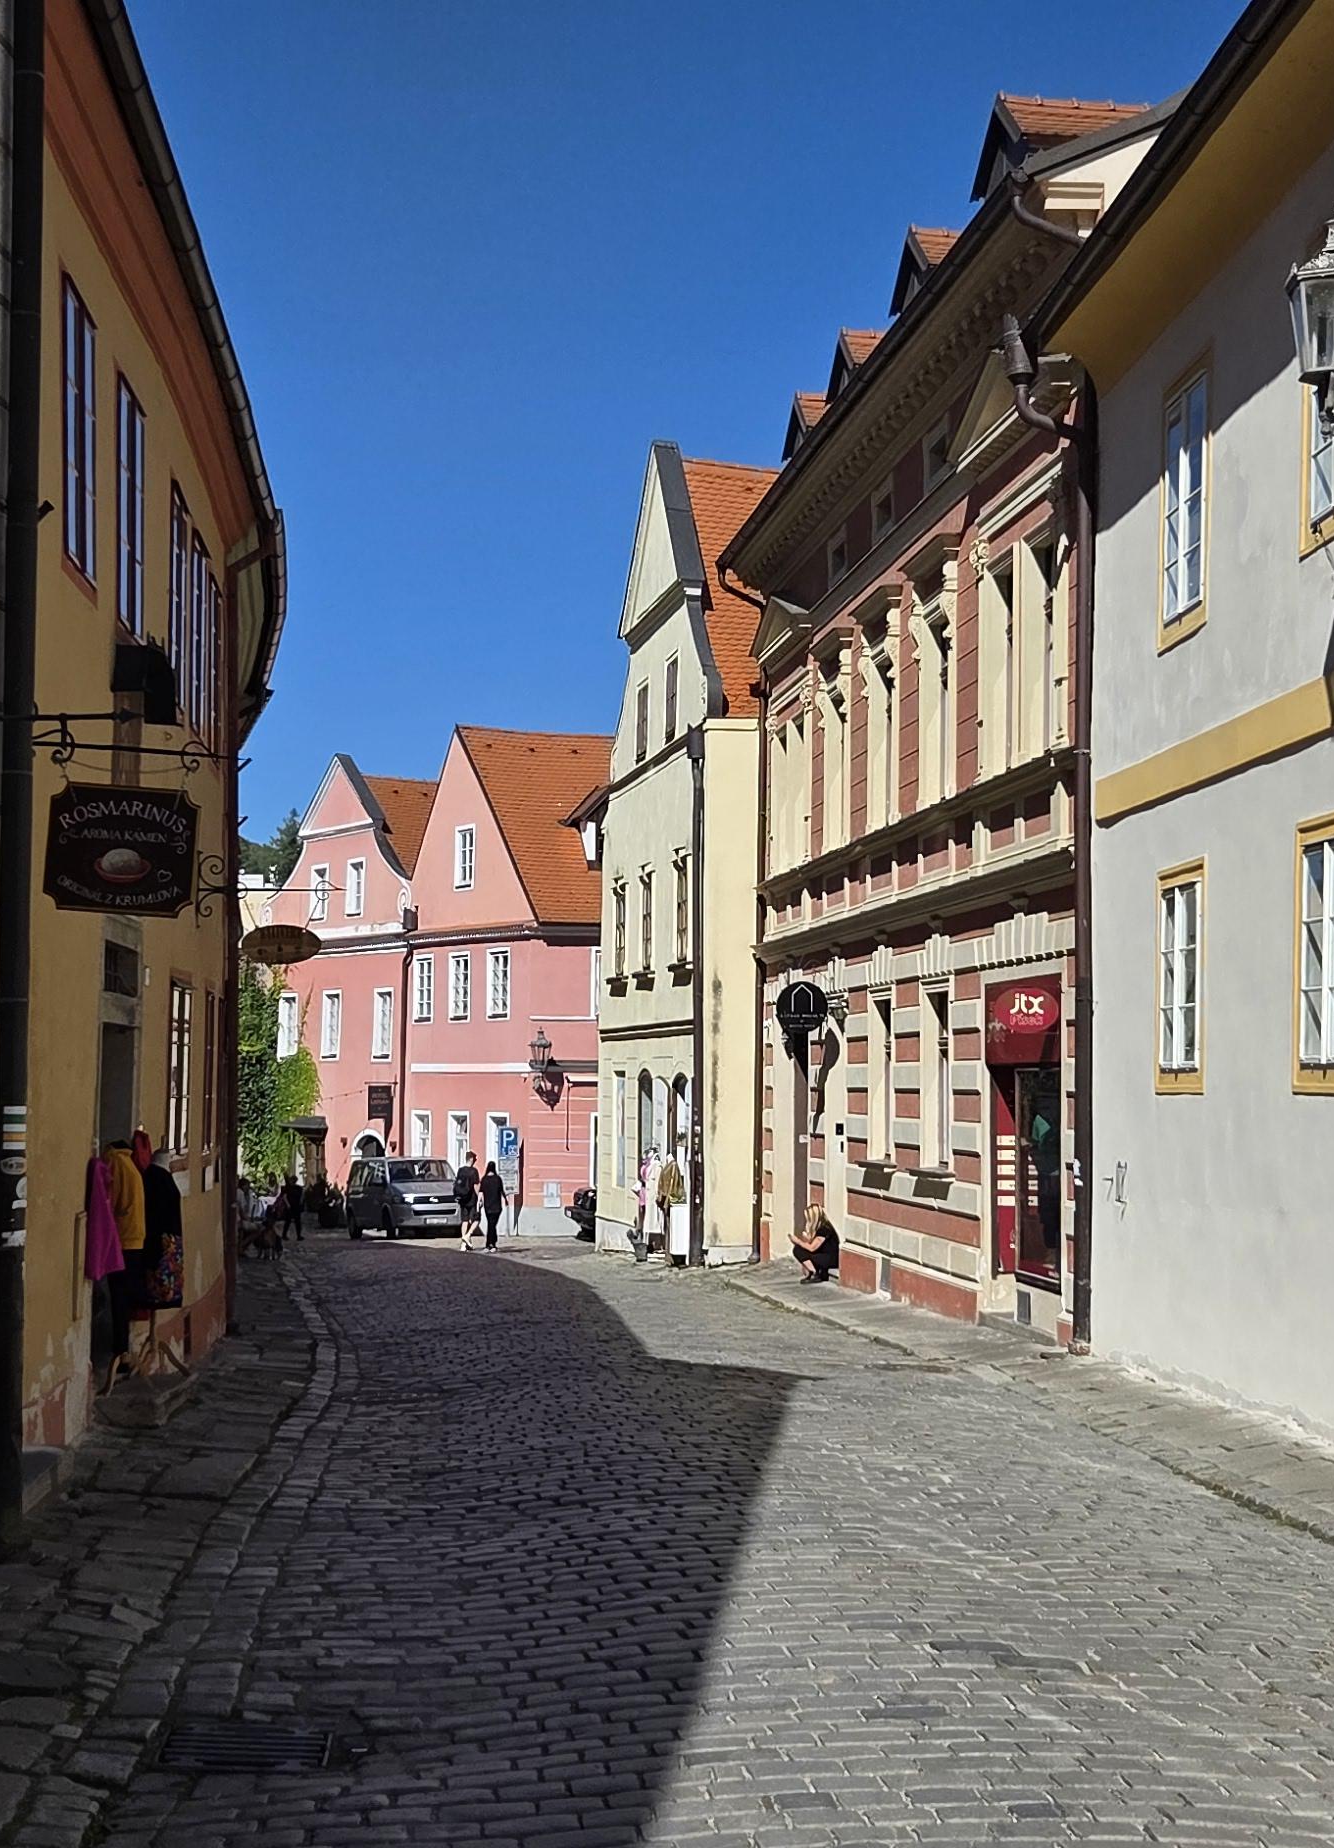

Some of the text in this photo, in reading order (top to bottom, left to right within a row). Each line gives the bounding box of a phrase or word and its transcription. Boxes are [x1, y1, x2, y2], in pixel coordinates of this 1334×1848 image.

[58, 800, 187, 833] ROSMARINUS
[105, 893, 114, 905] Z
[115, 885, 184, 906] KRUMLOVA
[502, 1129, 515, 1148] P
